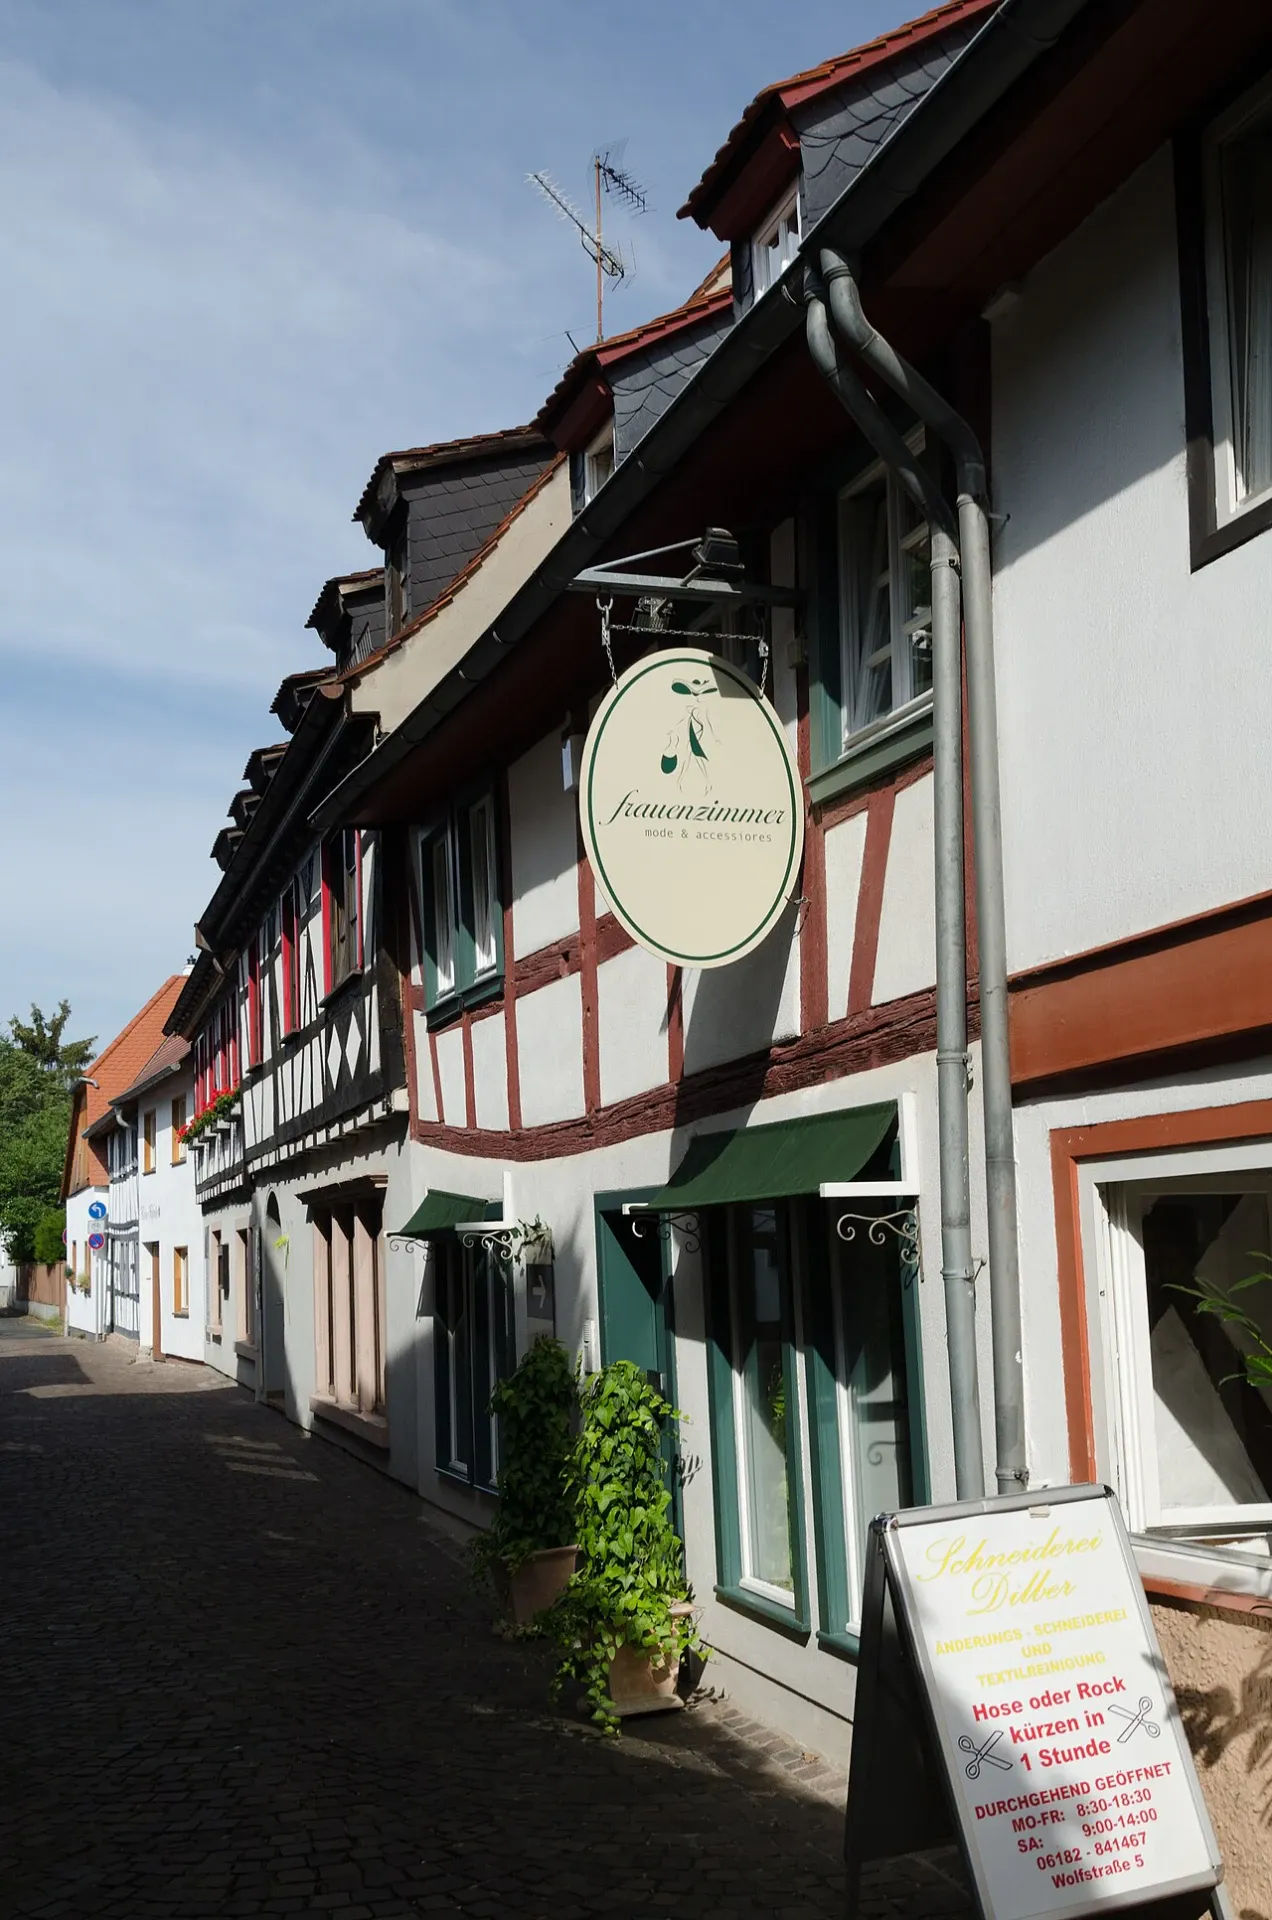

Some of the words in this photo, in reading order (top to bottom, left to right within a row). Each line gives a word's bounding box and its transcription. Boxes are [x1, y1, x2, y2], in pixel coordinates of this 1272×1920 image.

[598, 789, 785, 825] frauenzimmer
[644, 828, 674, 838] mode
[681, 829, 689, 838] &
[696, 831, 772, 842] accessiores
[916, 1526, 1103, 1582] Schneiderei
[966, 1569, 1077, 1616] Dilber
[935, 1628, 1023, 1655] ÄNDERUNGS
[1034, 1608, 1128, 1636] SCHNEIDEREI
[1021, 1643, 1052, 1658] UND
[976, 1651, 1107, 1687] TEXTILREINIGUNG
[972, 1698, 1023, 1721] Hose
[1029, 1689, 1071, 1709] oder
[1076, 1676, 1126, 1700] Rock
[1009, 1718, 1079, 1744] kürzen
[1084, 1710, 1104, 1728] in
[1020, 1753, 1031, 1771] 1
[1039, 1738, 1111, 1767] Stunde
[975, 1781, 1090, 1819] DURCHGEHEND
[1095, 1763, 1172, 1790] GEÖFFNET
[1011, 1810, 1065, 1833] MO-FR:
[1076, 1788, 1151, 1817] 8:30-18:30
[1018, 1836, 1044, 1853] SA:
[1082, 1808, 1157, 1837] 9:00-14:00
[1037, 1848, 1082, 1871] 06182
[1094, 1832, 1147, 1856] 841467
[1052, 1859, 1130, 1889] Wolfstraße
[1135, 1854, 1144, 1867] 5
